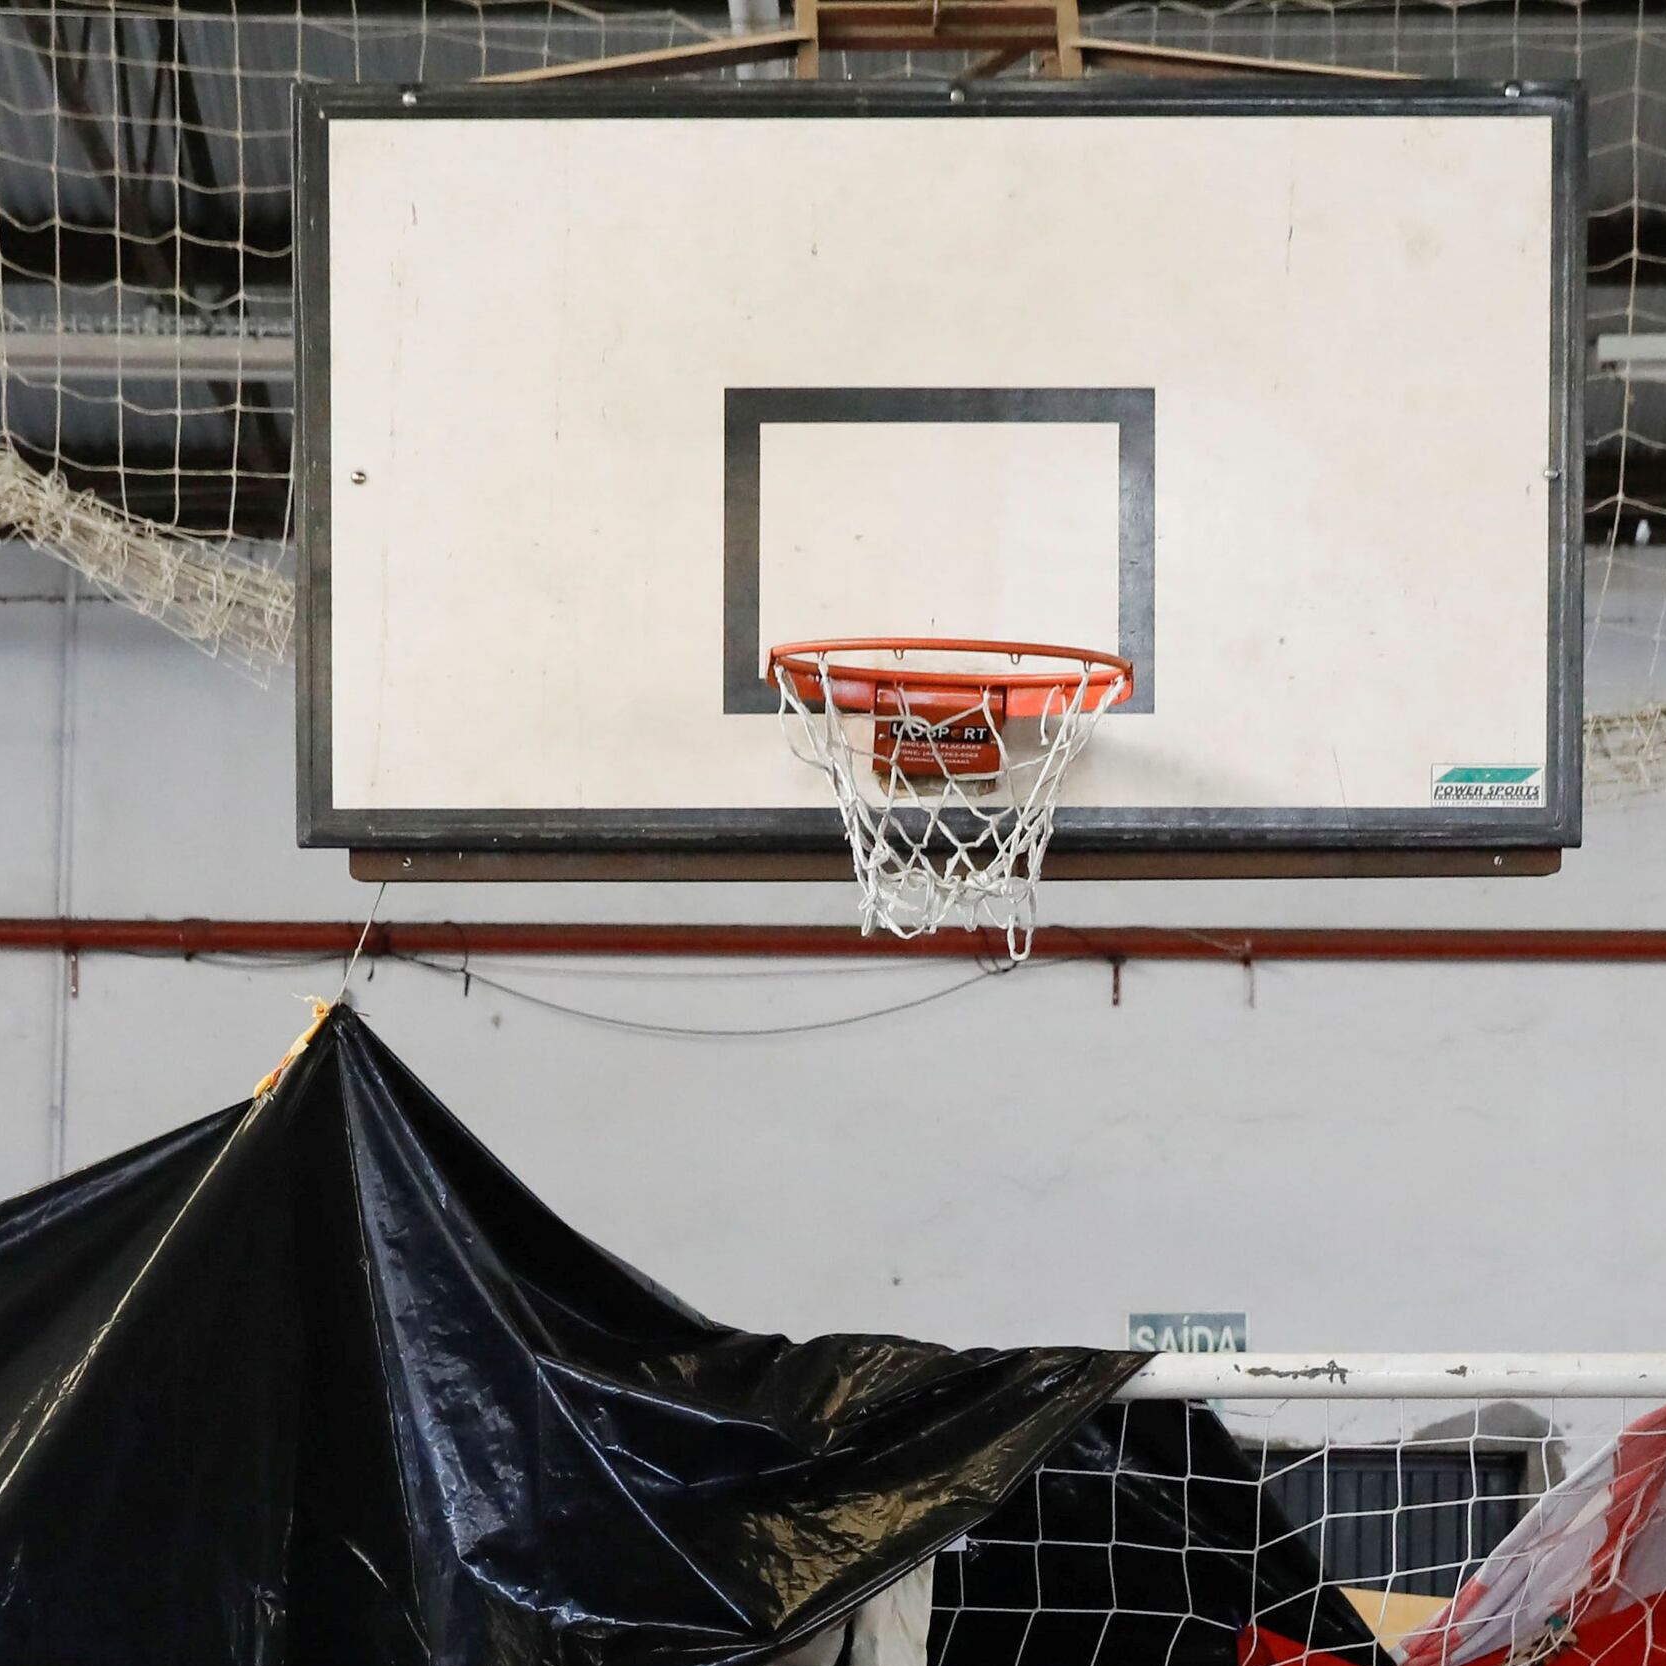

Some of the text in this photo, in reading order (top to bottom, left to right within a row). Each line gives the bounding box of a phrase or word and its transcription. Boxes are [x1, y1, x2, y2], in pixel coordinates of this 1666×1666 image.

[1434, 785, 1540, 797] POWER SPORTS
[1136, 1315, 1237, 1352] SAÍDA
